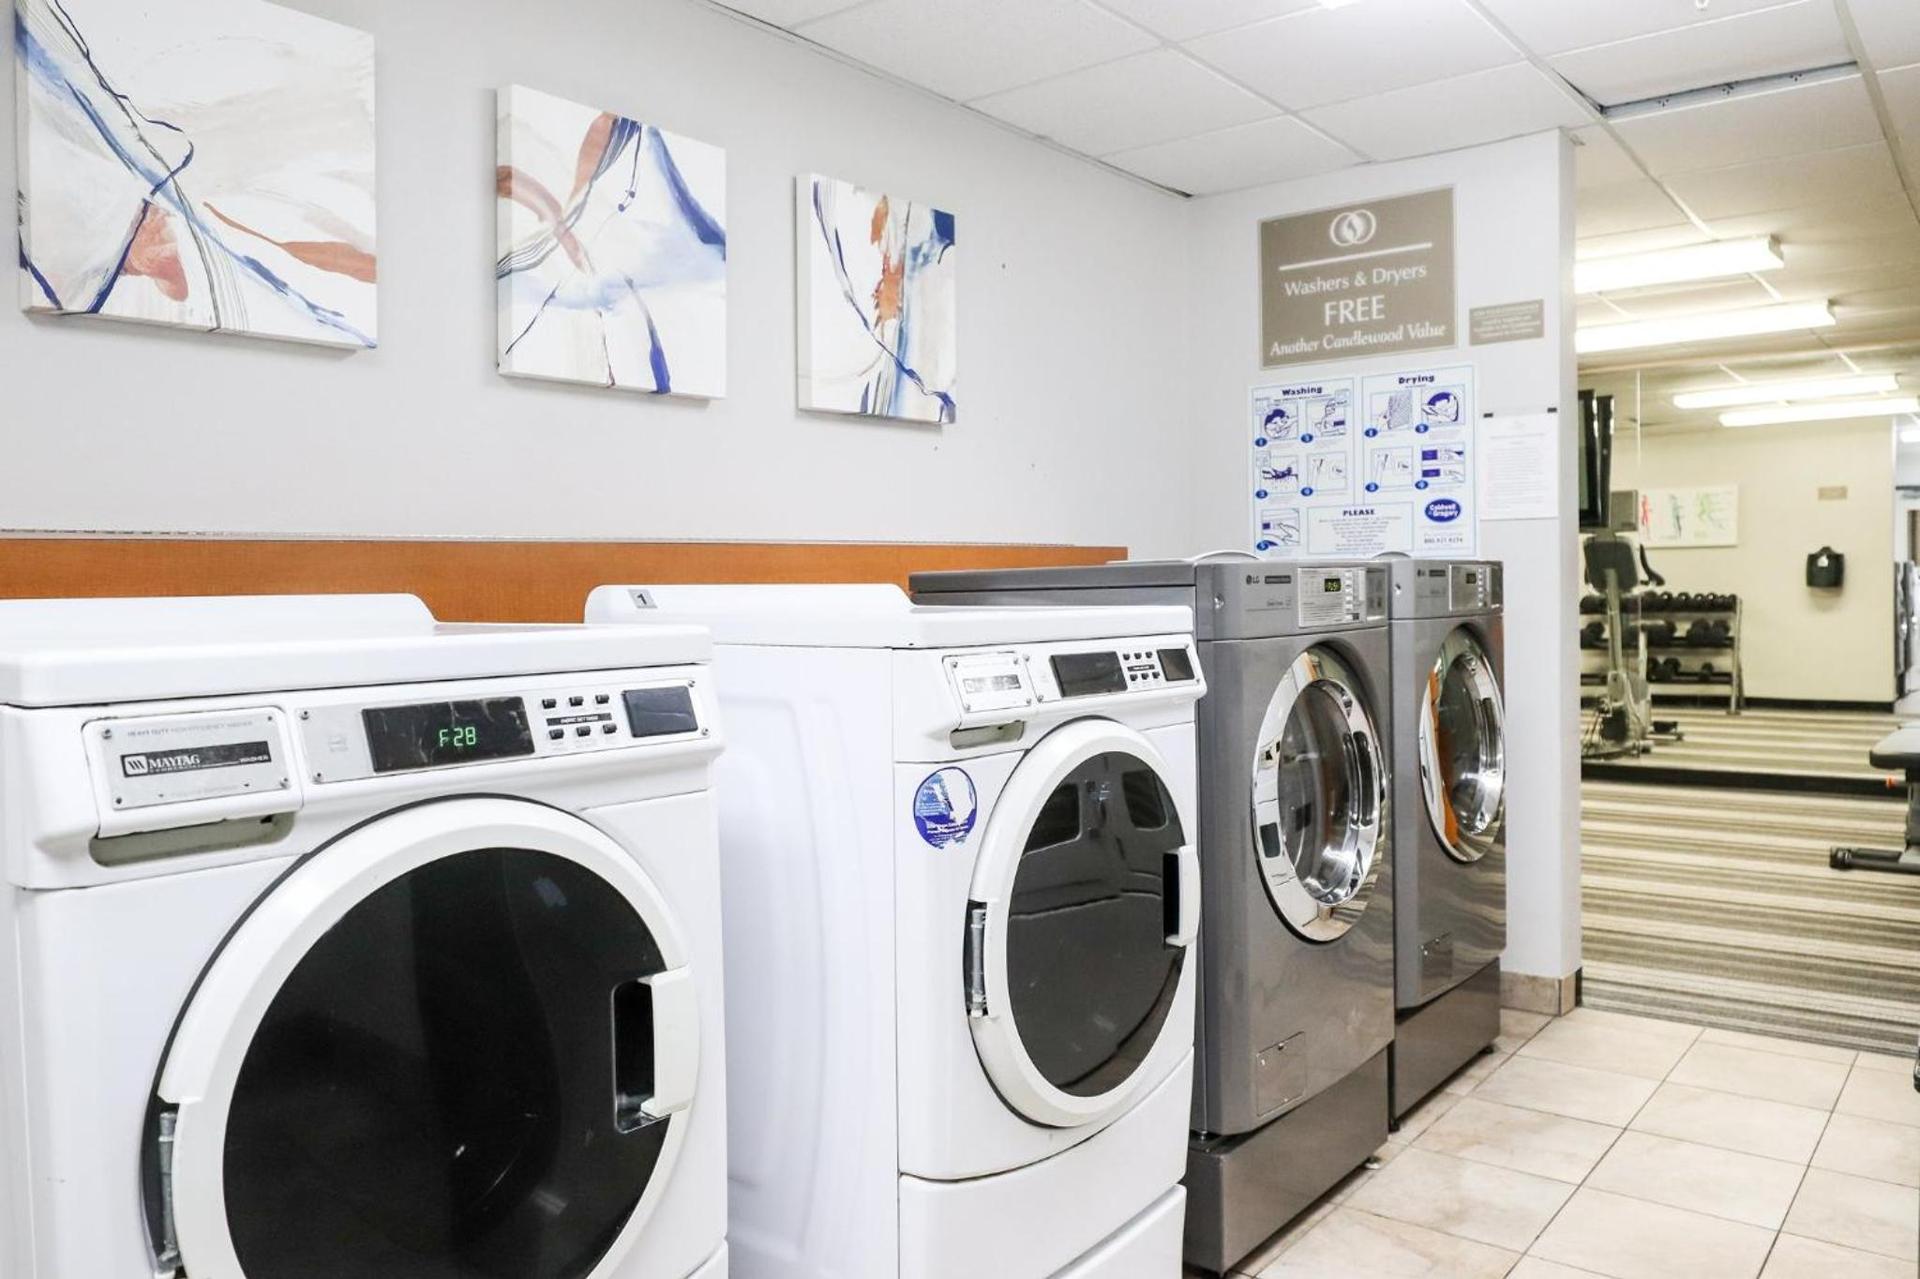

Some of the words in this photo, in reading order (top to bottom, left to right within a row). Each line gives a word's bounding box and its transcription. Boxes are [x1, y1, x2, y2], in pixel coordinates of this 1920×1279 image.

[1284, 274, 1350, 297] Washers
[1355, 271, 1367, 286] &
[1372, 263, 1427, 285] Dryers
[1324, 295, 1385, 325] FREE
[1270, 338, 1320, 357] Another
[1322, 325, 1404, 350] Candlewood
[1406, 321, 1447, 340] Value
[1398, 375, 1435, 385] Drying
[1281, 386, 1323, 396] Washing
[1342, 508, 1376, 517] PLEASE
[636, 593, 648, 605] 1
[439, 726, 476, 748] F28
[148, 754, 201, 770] MAYTAG
